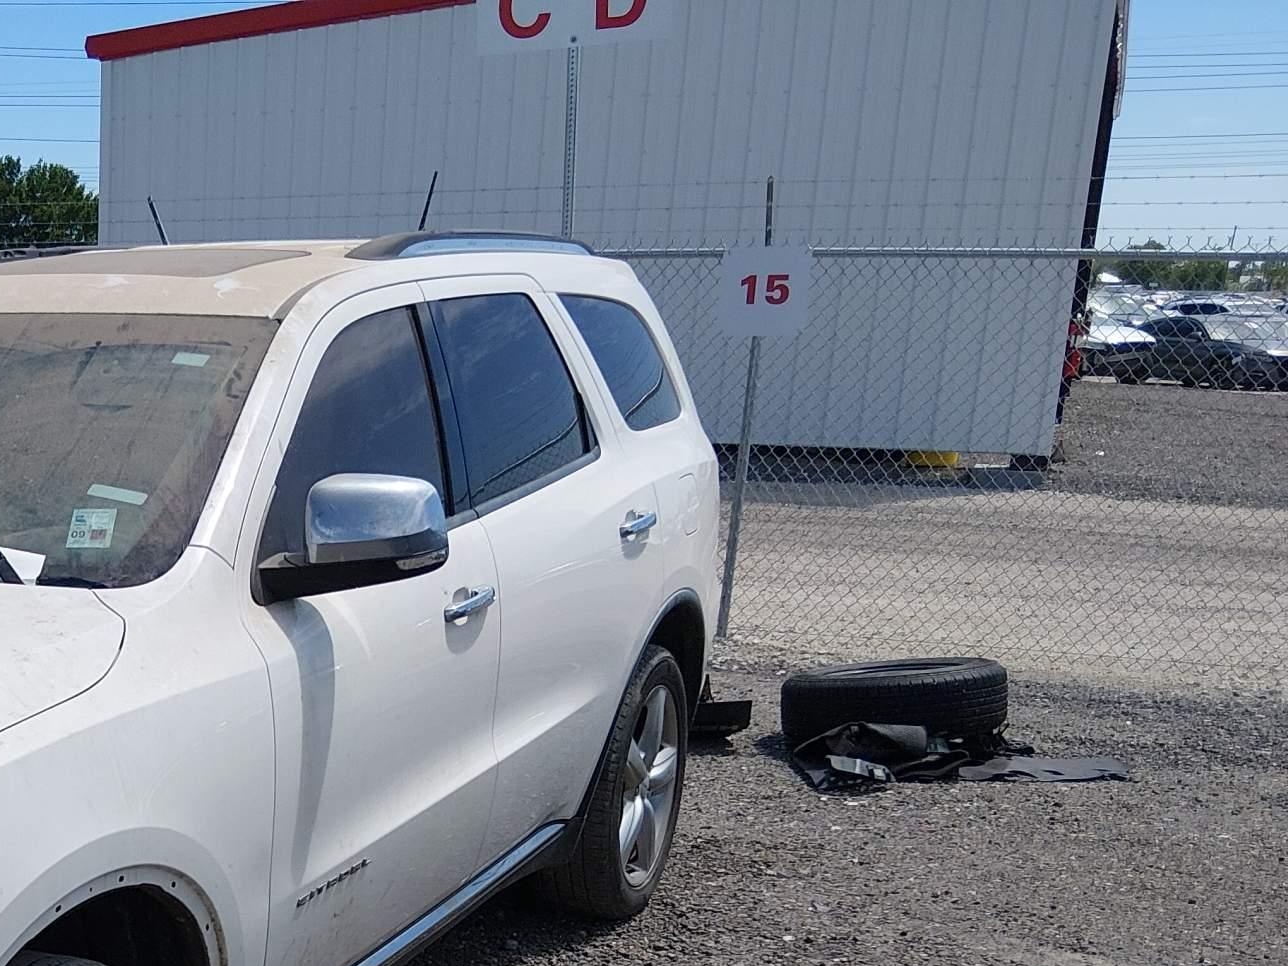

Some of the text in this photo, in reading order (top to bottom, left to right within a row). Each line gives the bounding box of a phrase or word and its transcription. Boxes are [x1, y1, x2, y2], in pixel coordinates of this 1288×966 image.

[499, 0, 648, 39] C D
[740, 274, 790, 305] 15
[71, 530, 86, 539] 09
[296, 858, 372, 908] CITADEL
